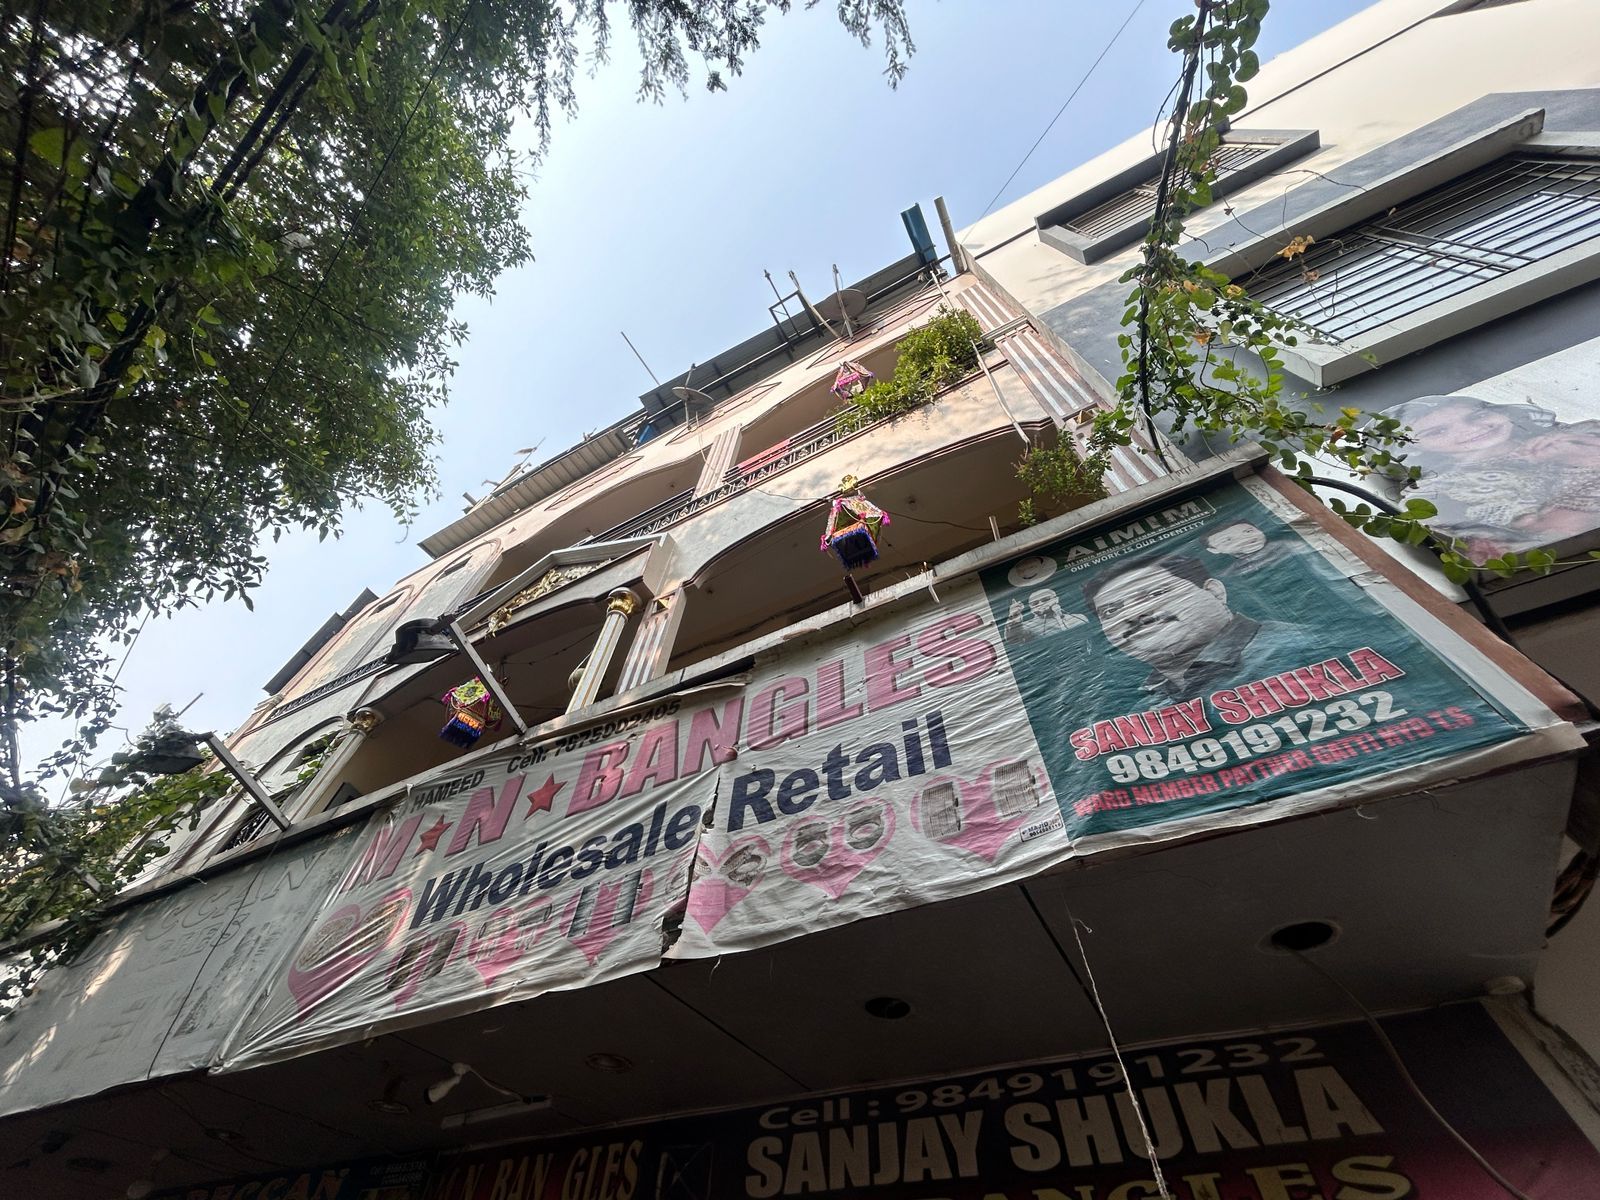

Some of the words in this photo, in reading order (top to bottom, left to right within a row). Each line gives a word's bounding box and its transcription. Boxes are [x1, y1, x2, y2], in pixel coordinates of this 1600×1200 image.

[1070, 562, 1090, 573] OUR
[1092, 551, 1121, 566] WORK
[1123, 546, 1135, 555] IS
[1135, 538, 1157, 550] OUR
[1158, 520, 1206, 542] IDENTITY
[444, 772, 527, 857] N
[565, 612, 998, 818] BANGLES
[1069, 698, 1212, 762] SANJAY
[1210, 646, 1406, 725] SHUKLA
[1105, 690, 1408, 784] 9849191232
[409, 769, 486, 813] HAMEED
[1073, 785, 1133, 818] WARD
[1134, 772, 1218, 807] MEMBER
[1310, 730, 1382, 766] GATTI
[1378, 717, 1436, 750] HYD
[408, 802, 703, 930] Wholesale
[727, 710, 952, 832] Retail
[744, 1110, 984, 1199] SANJAY
[1004, 1065, 1386, 1172] SHUKLA
[758, 1097, 850, 1130] Cell
[895, 1036, 1326, 1113] 9849191232
